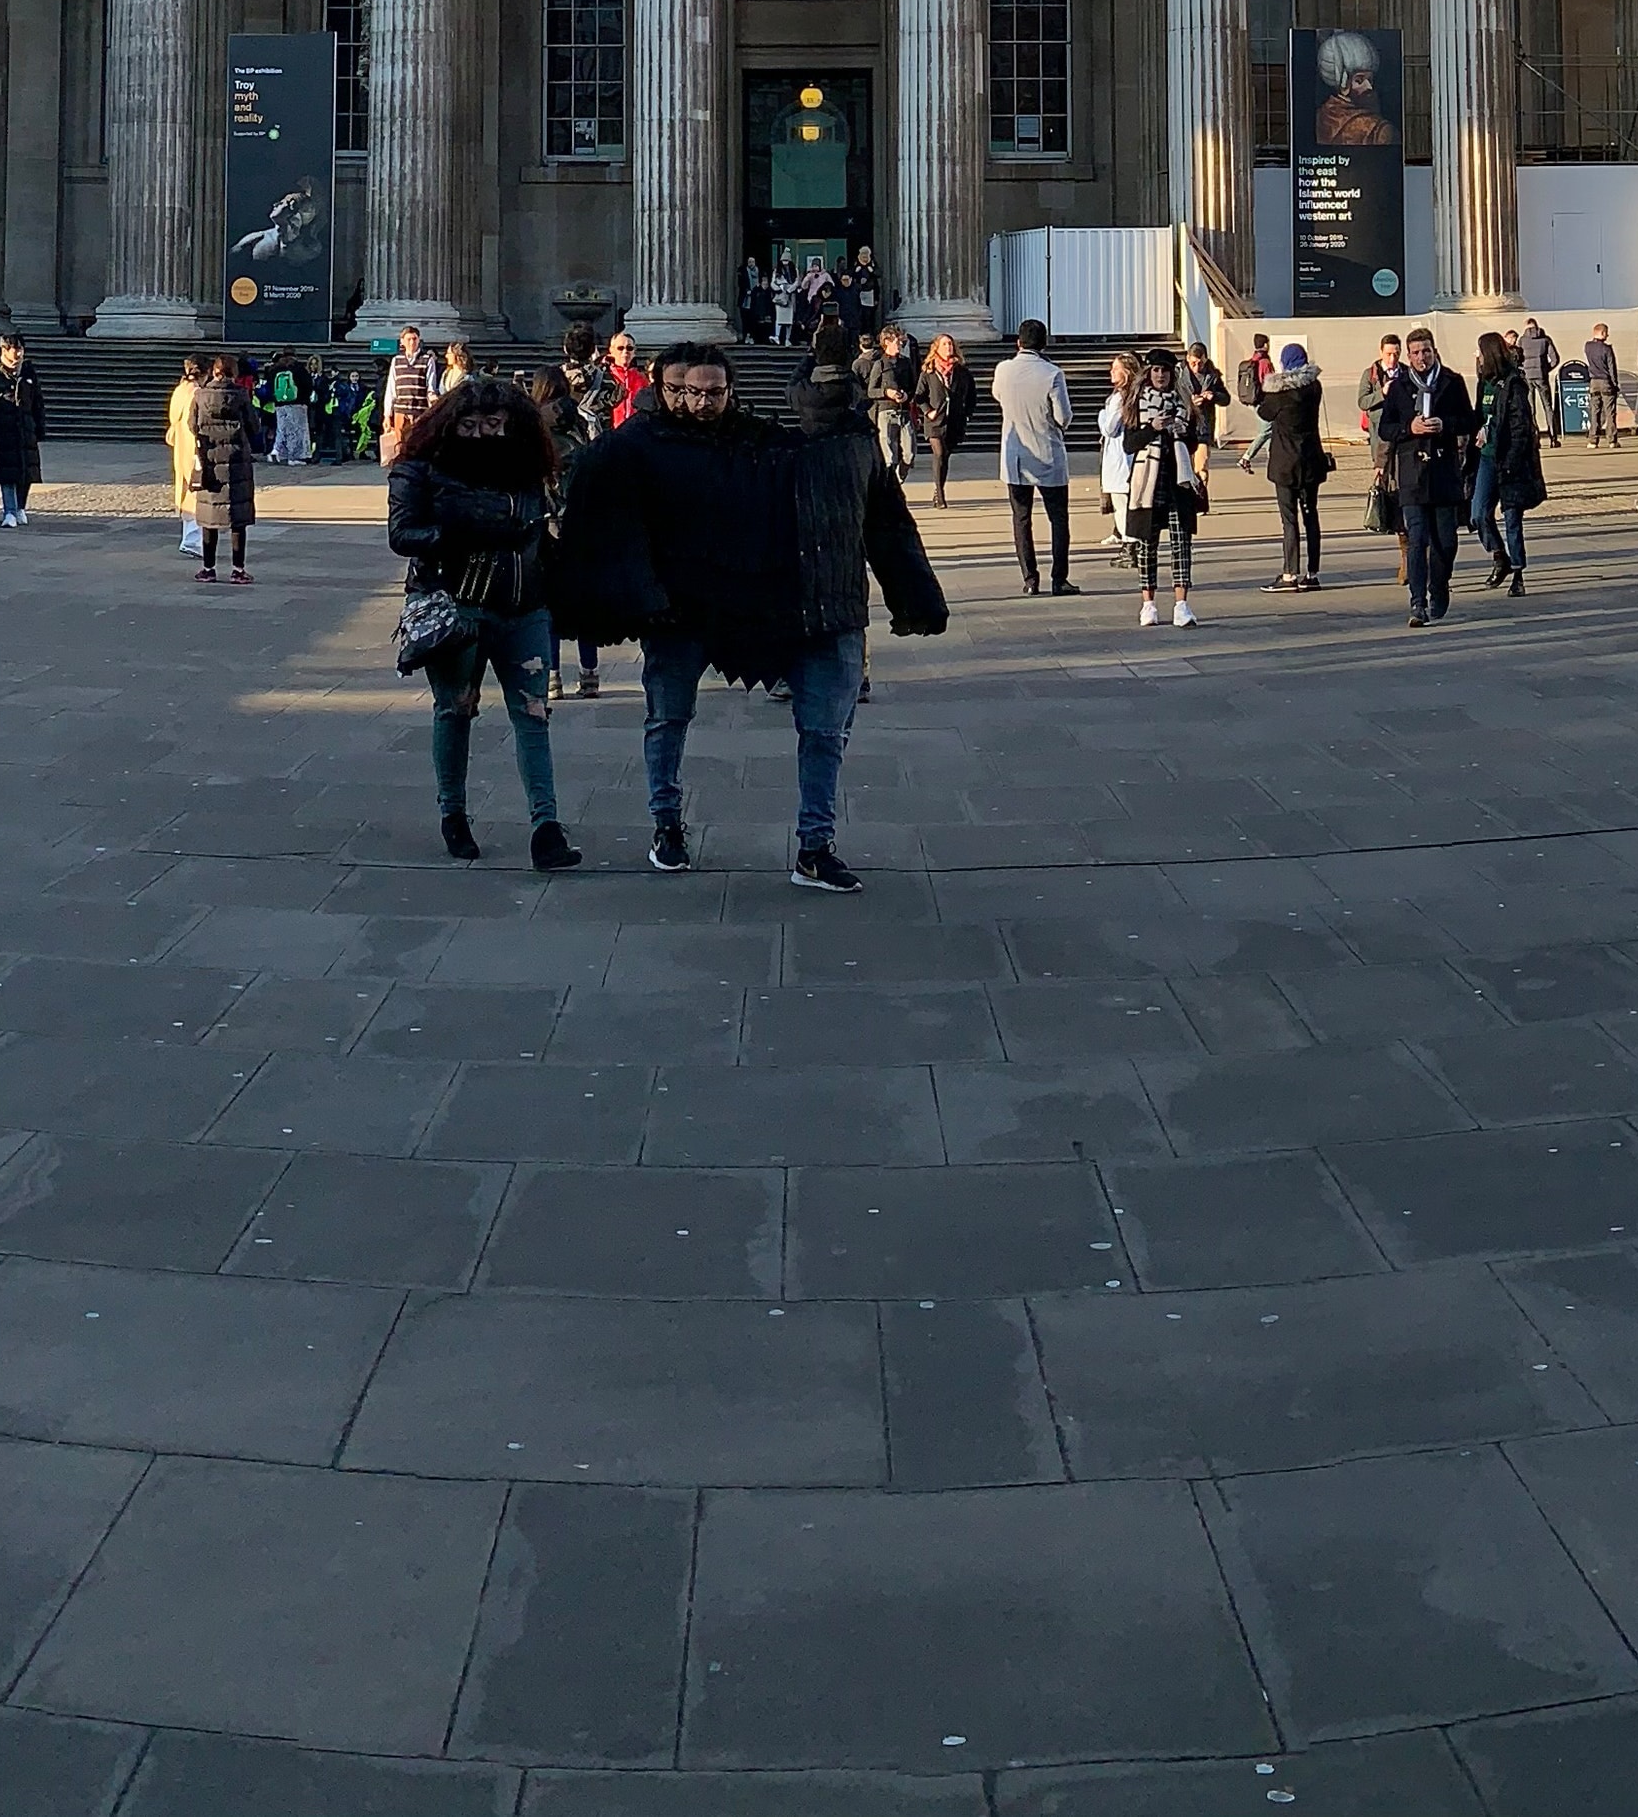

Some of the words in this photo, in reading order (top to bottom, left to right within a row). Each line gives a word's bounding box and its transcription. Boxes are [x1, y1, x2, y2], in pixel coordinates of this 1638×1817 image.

[235, 81, 255, 91] Troy
[235, 92, 258, 101] myth
[234, 103, 251, 111] and
[234, 113, 263, 123] reality
[1299, 155, 1336, 165] Inspired
[1339, 156, 1350, 166] by
[1299, 167, 1314, 175] the
[1316, 167, 1337, 175] east
[1299, 178, 1319, 186] how
[1320, 178, 1337, 186] the
[1299, 189, 1332, 198] Islamic
[1334, 189, 1360, 198] world
[1299, 200, 1348, 209] influenced
[1299, 212, 1336, 220] western
[1338, 212, 1352, 220] art
